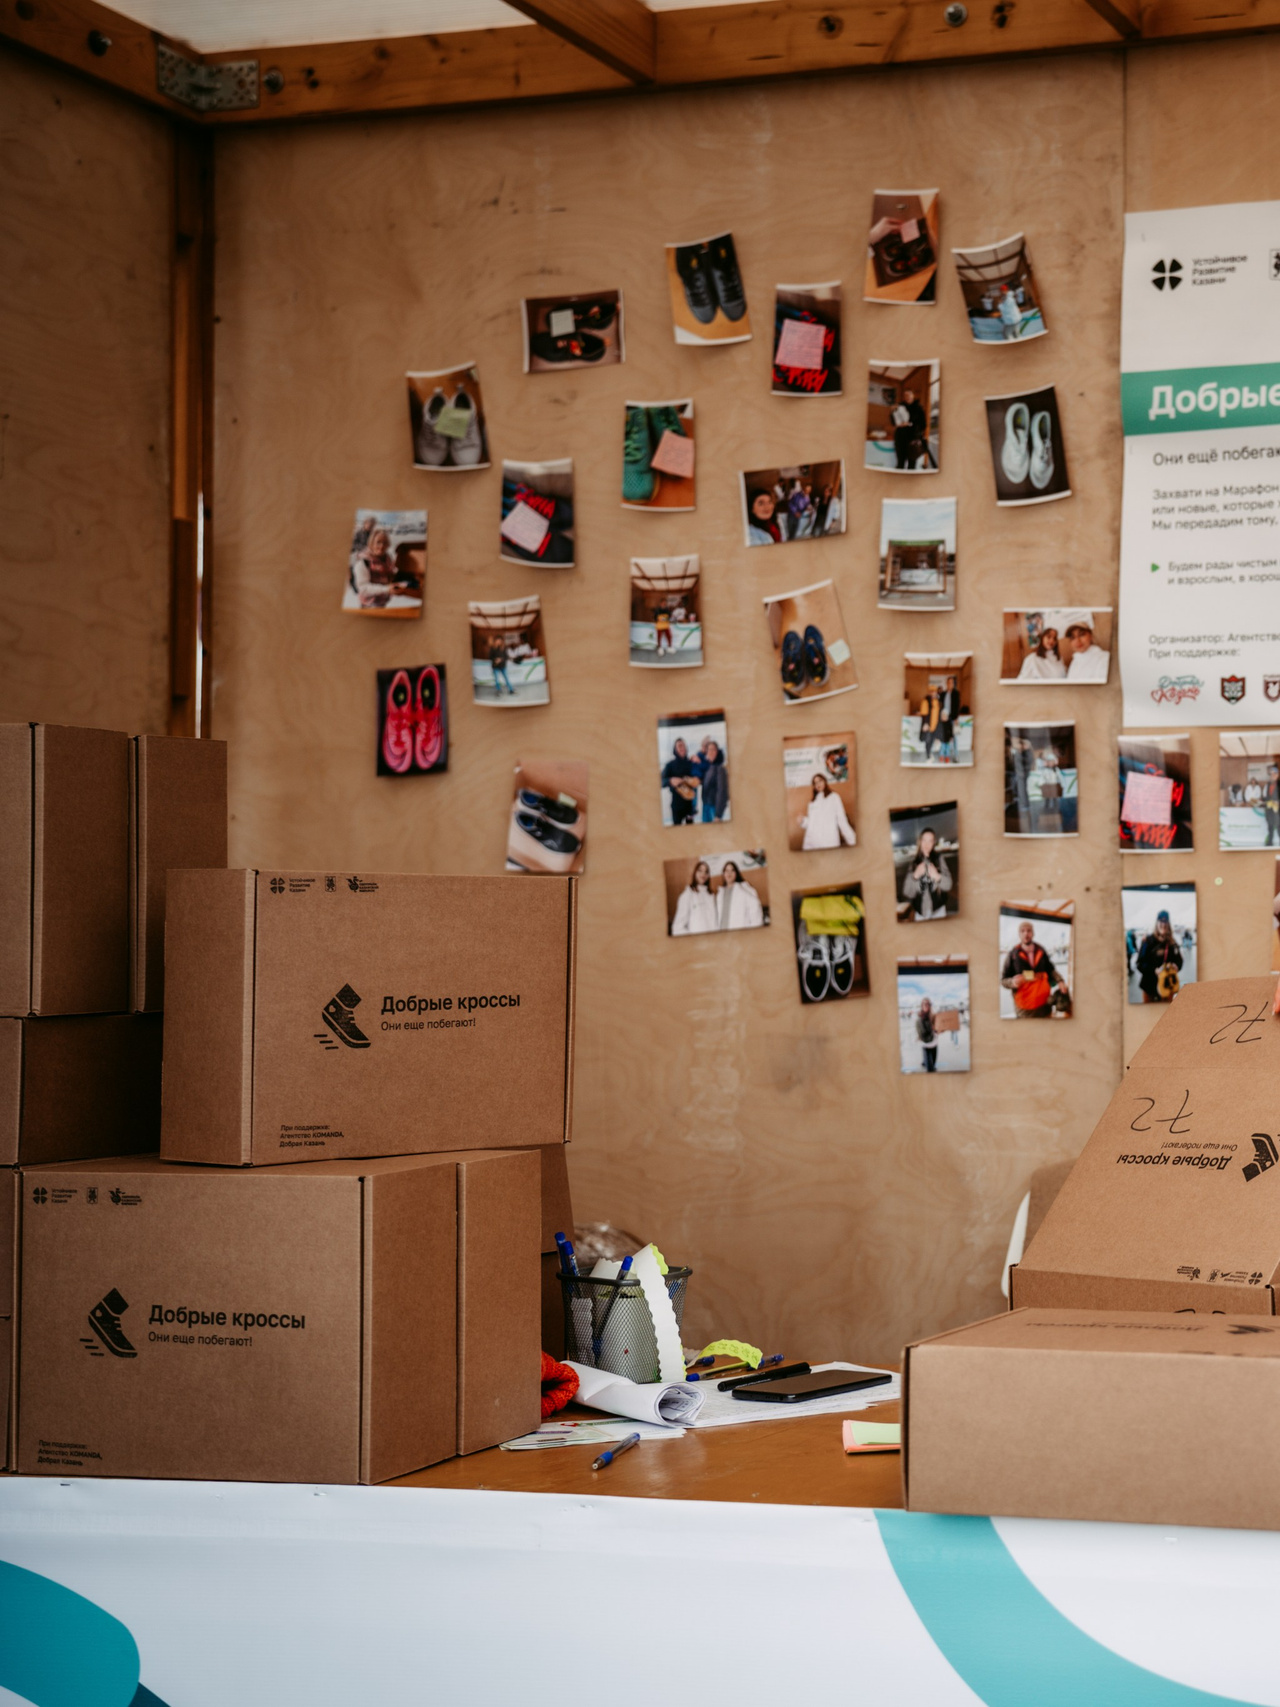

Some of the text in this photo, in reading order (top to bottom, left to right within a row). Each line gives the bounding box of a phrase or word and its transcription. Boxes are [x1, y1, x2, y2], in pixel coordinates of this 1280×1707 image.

[1153, 452, 1184, 466] Они
[1188, 449, 1218, 465] ещё
[1153, 488, 1202, 500] Захвати
[1206, 488, 1220, 497] на
[1223, 483, 1279, 498] Марафон
[1152, 505, 1175, 516] или
[1179, 502, 1219, 515] новые,
[1223, 500, 1274, 514] которые
[1152, 519, 1171, 530] Мы
[1175, 517, 1243, 531] передадим
[1247, 514, 1278, 527] тому,
[1205, 563, 1233, 571] рады
[1236, 559, 1277, 568] чистым
[1177, 575, 1236, 586] взрослым,
[1149, 634, 1224, 646] Организатор:
[1149, 648, 1240, 660] При поддержке:
[381, 994, 520, 1015] Добрые кроссы
[381, 1018, 476, 1031] Они еще побегают!
[1210, 1001, 1269, 1044] 72
[1131, 1089, 1193, 1133] 72
[1161, 1141, 1202, 1150] побегают!
[1116, 1153, 1232, 1170] Добрые кроссы
[149, 1305, 306, 1331] Добрые кроссы
[149, 1331, 253, 1347] Они еще побегают!
